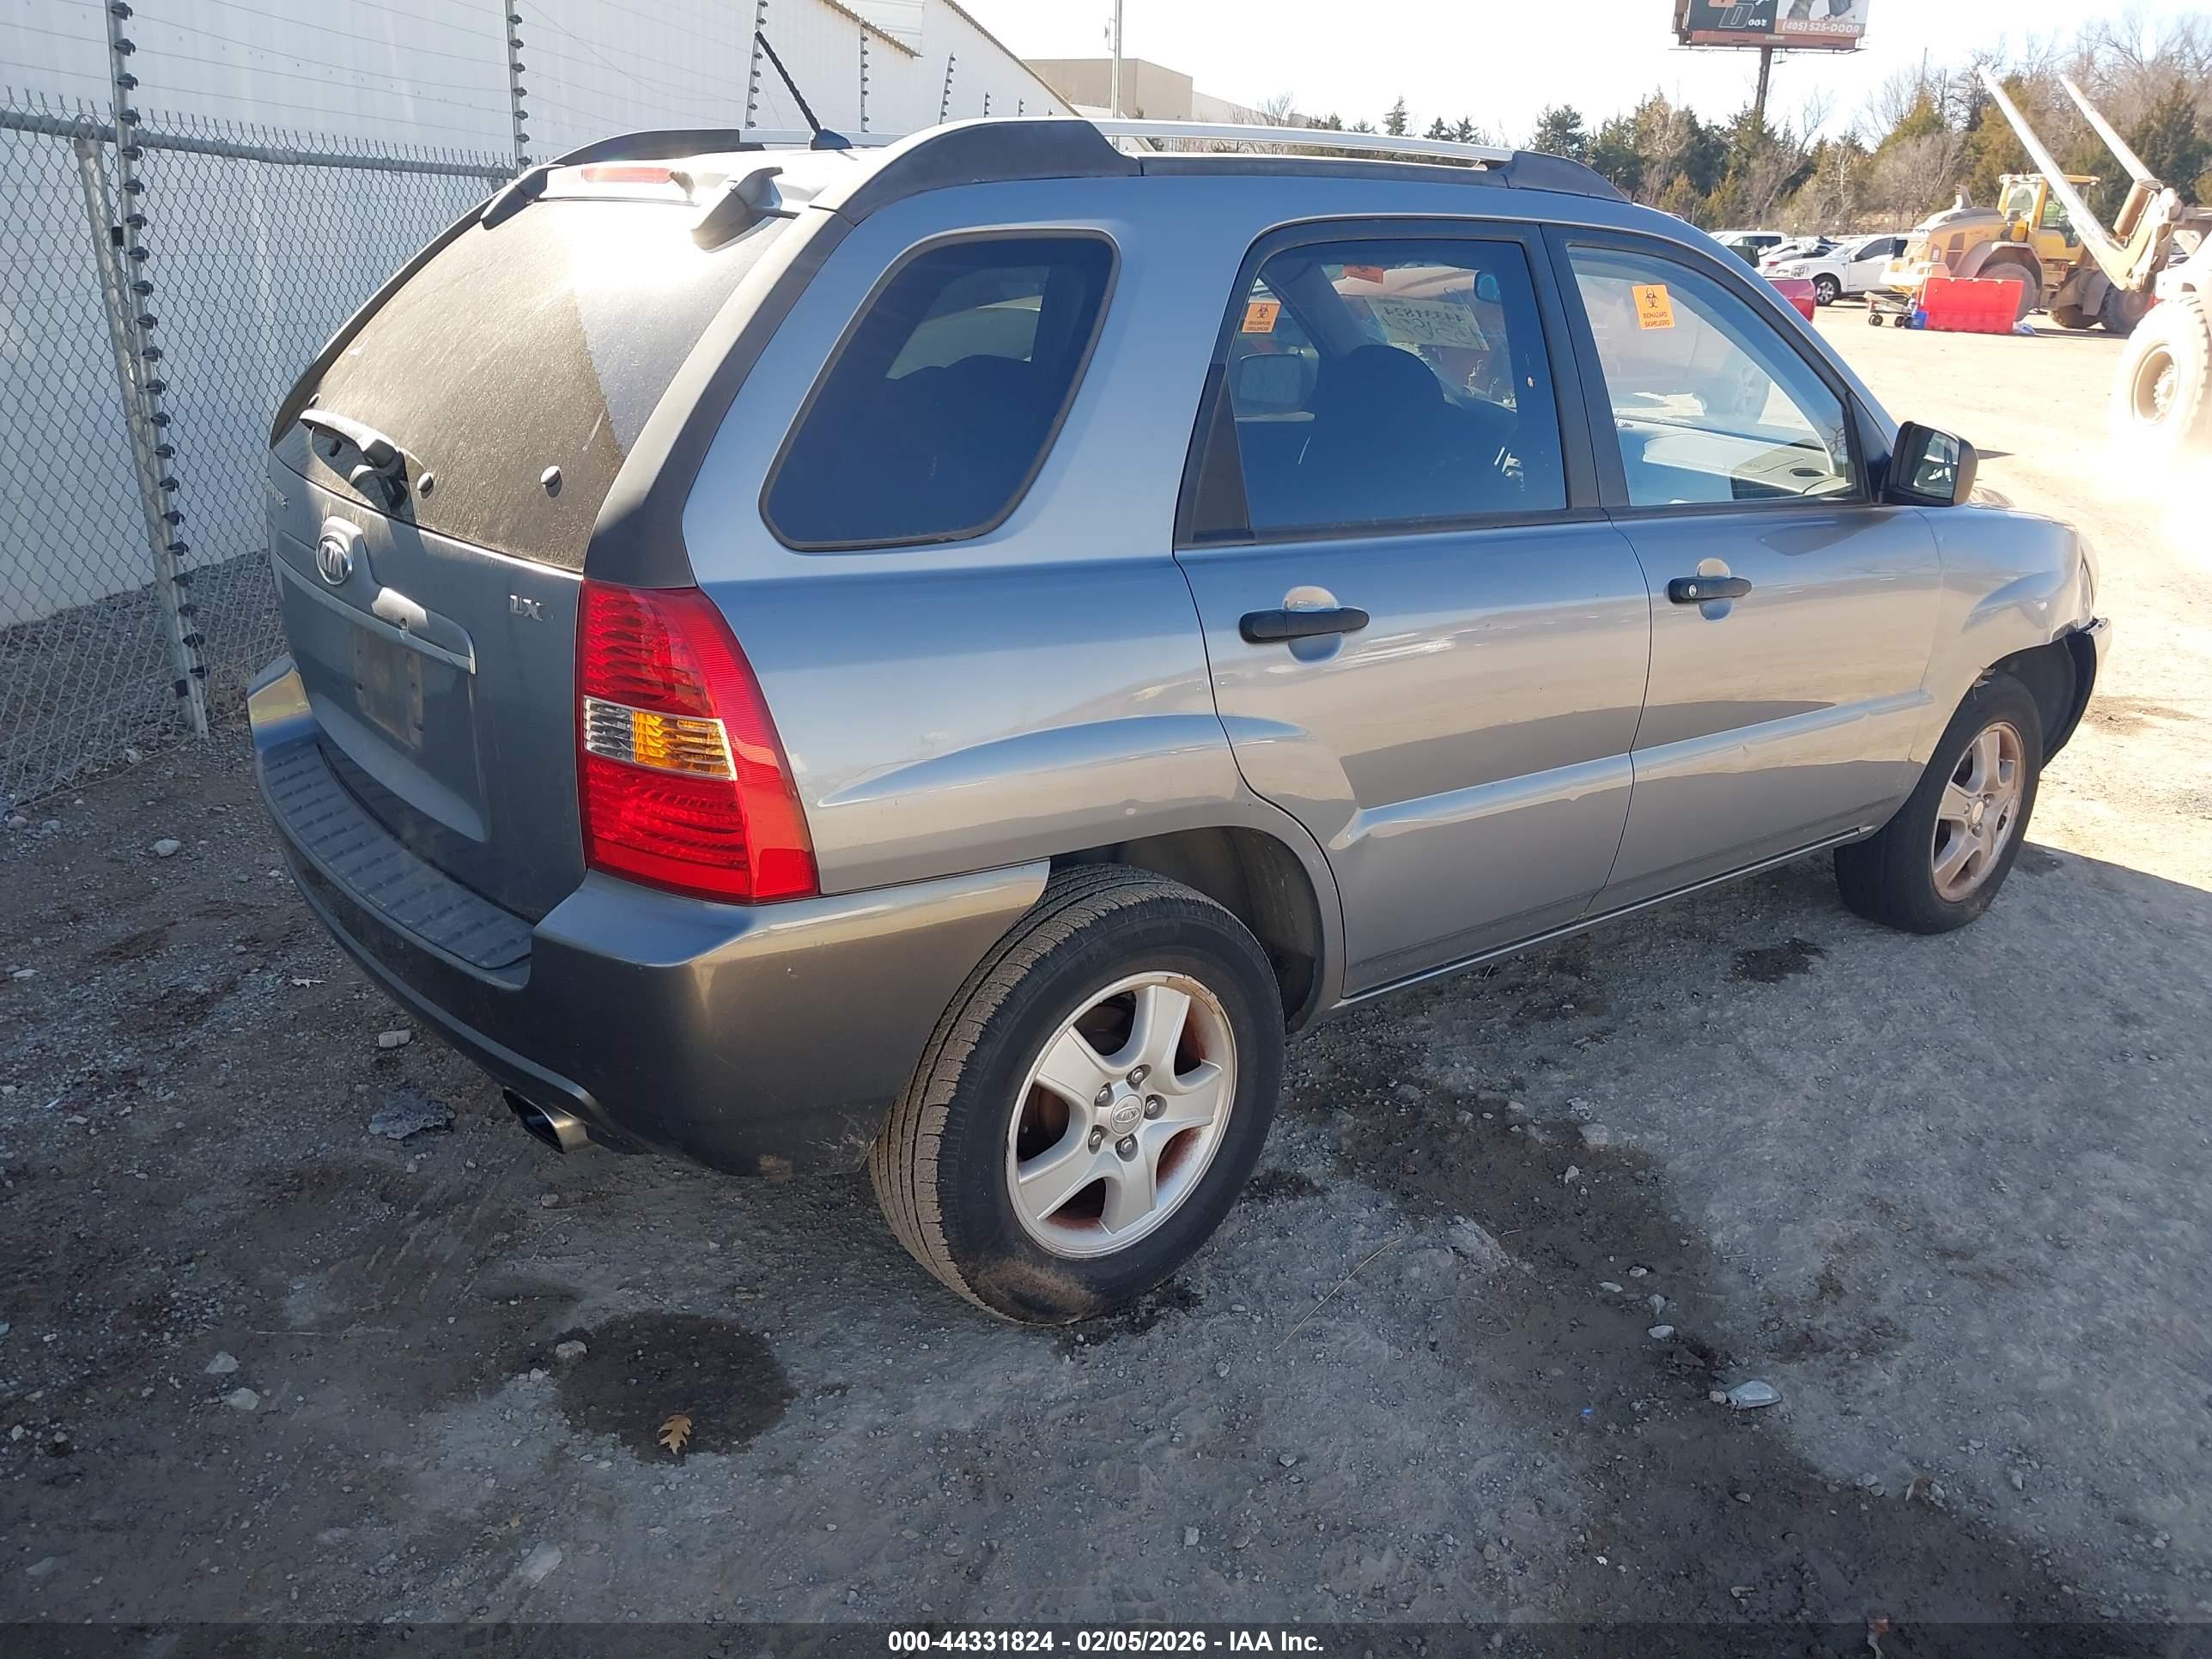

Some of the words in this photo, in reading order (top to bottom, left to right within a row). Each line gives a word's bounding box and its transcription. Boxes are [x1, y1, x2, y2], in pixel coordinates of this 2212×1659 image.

[1782, 21, 1808, 32] (405)
[1808, 22, 1861, 34] 525-DOOR
[509, 594, 544, 622] LX
